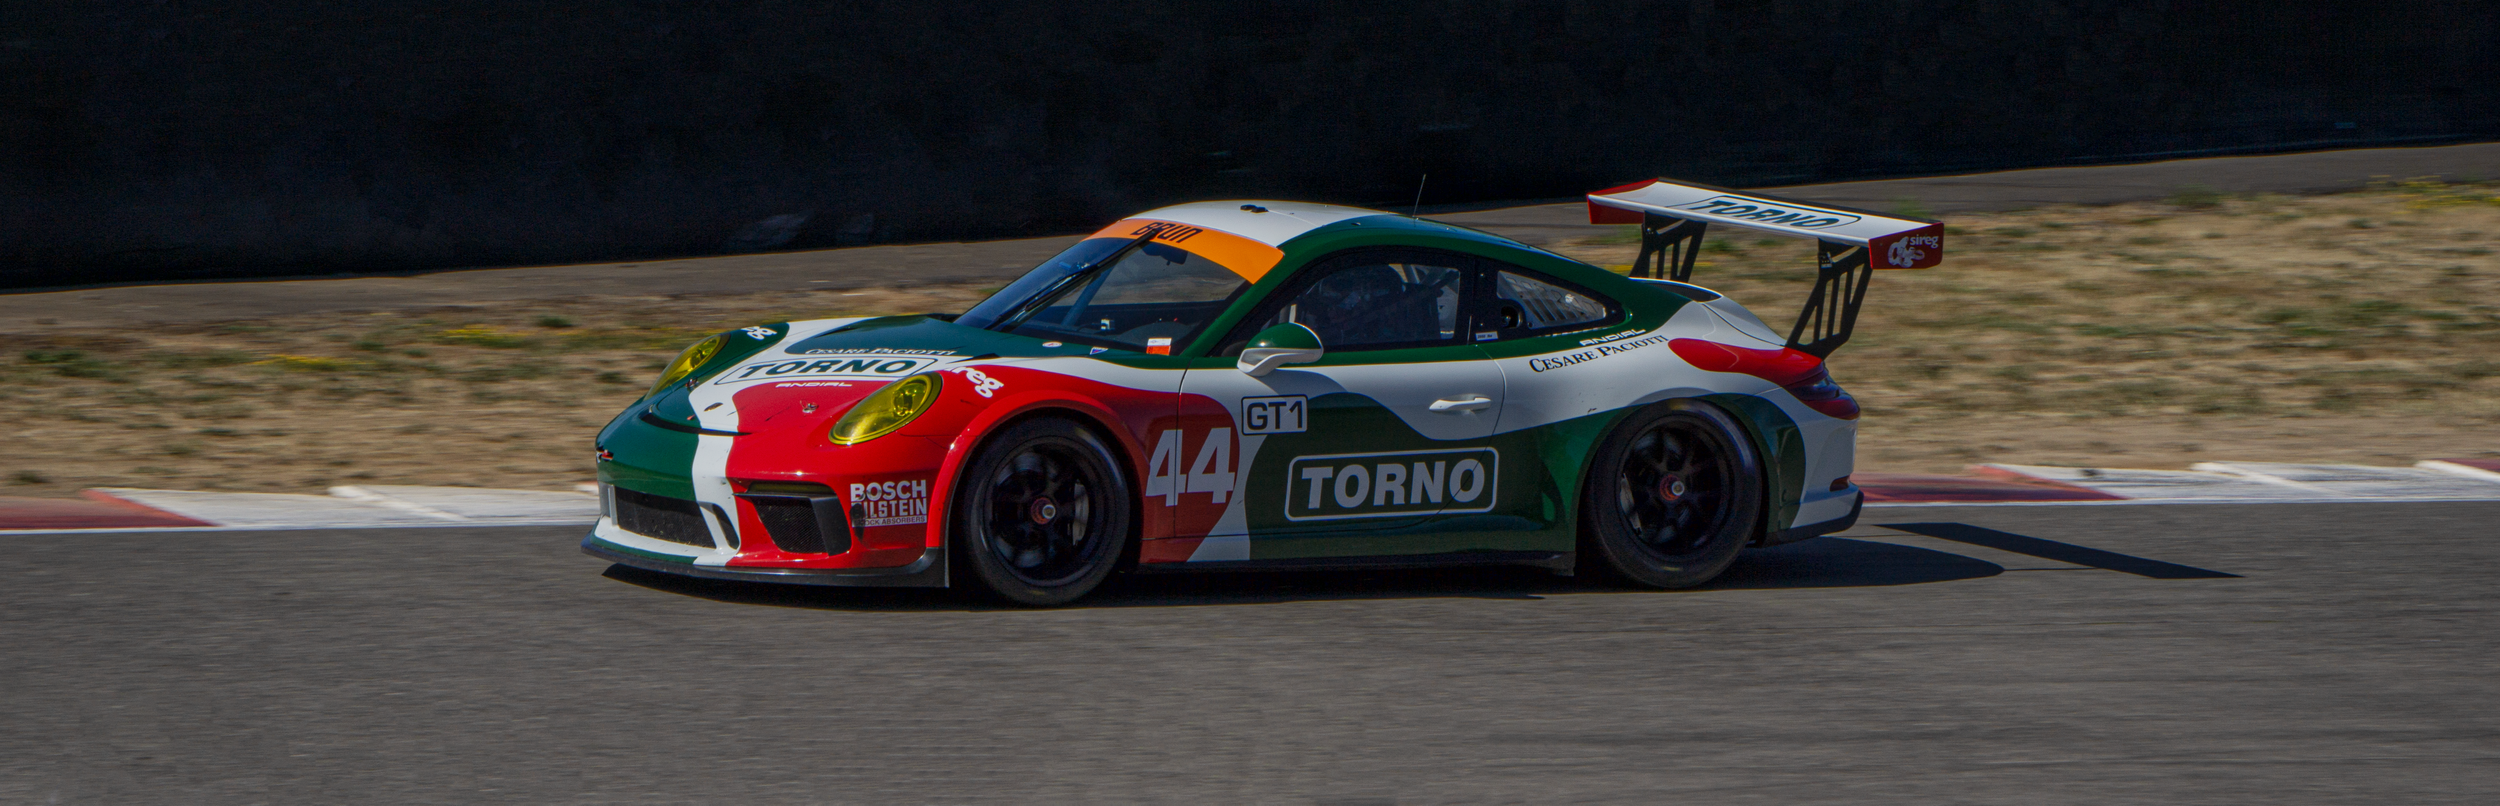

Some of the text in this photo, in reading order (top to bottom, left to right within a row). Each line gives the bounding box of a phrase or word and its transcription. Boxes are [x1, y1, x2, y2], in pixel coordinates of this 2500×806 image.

[1687, 200, 1840, 227] TORNO
[1130, 221, 1204, 244] BRUN
[1909, 234, 1939, 249] sireg
[1579, 328, 1647, 347] ANDIAL
[737, 359, 918, 379] TORNO
[1246, 400, 1303, 431] GT1
[1145, 426, 1236, 507] 44
[850, 480, 926, 502] BOSCH
[1301, 458, 1485, 509] TORNO
[851, 498, 927, 518] ILSTEIN
[881, 515, 926, 525] ABSORBERS
